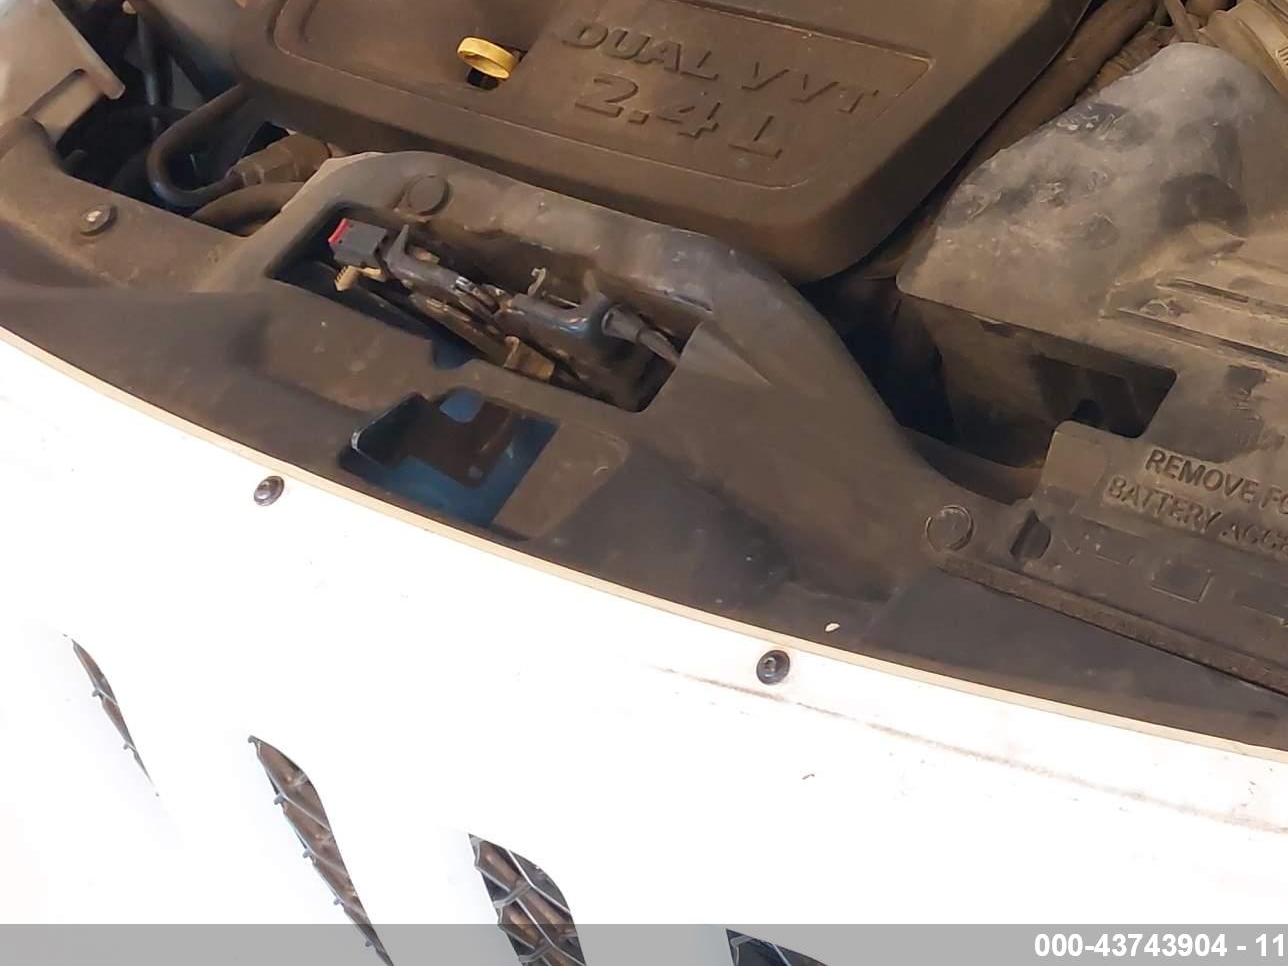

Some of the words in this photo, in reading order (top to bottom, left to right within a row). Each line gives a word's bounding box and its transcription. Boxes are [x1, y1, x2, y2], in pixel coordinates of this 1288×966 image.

[562, 19, 719, 81] DUAL
[740, 61, 880, 114] VVT
[575, 75, 784, 160] 2.4L
[1105, 478, 1222, 534] BATTERY
[1144, 448, 1258, 504] REMOVE
